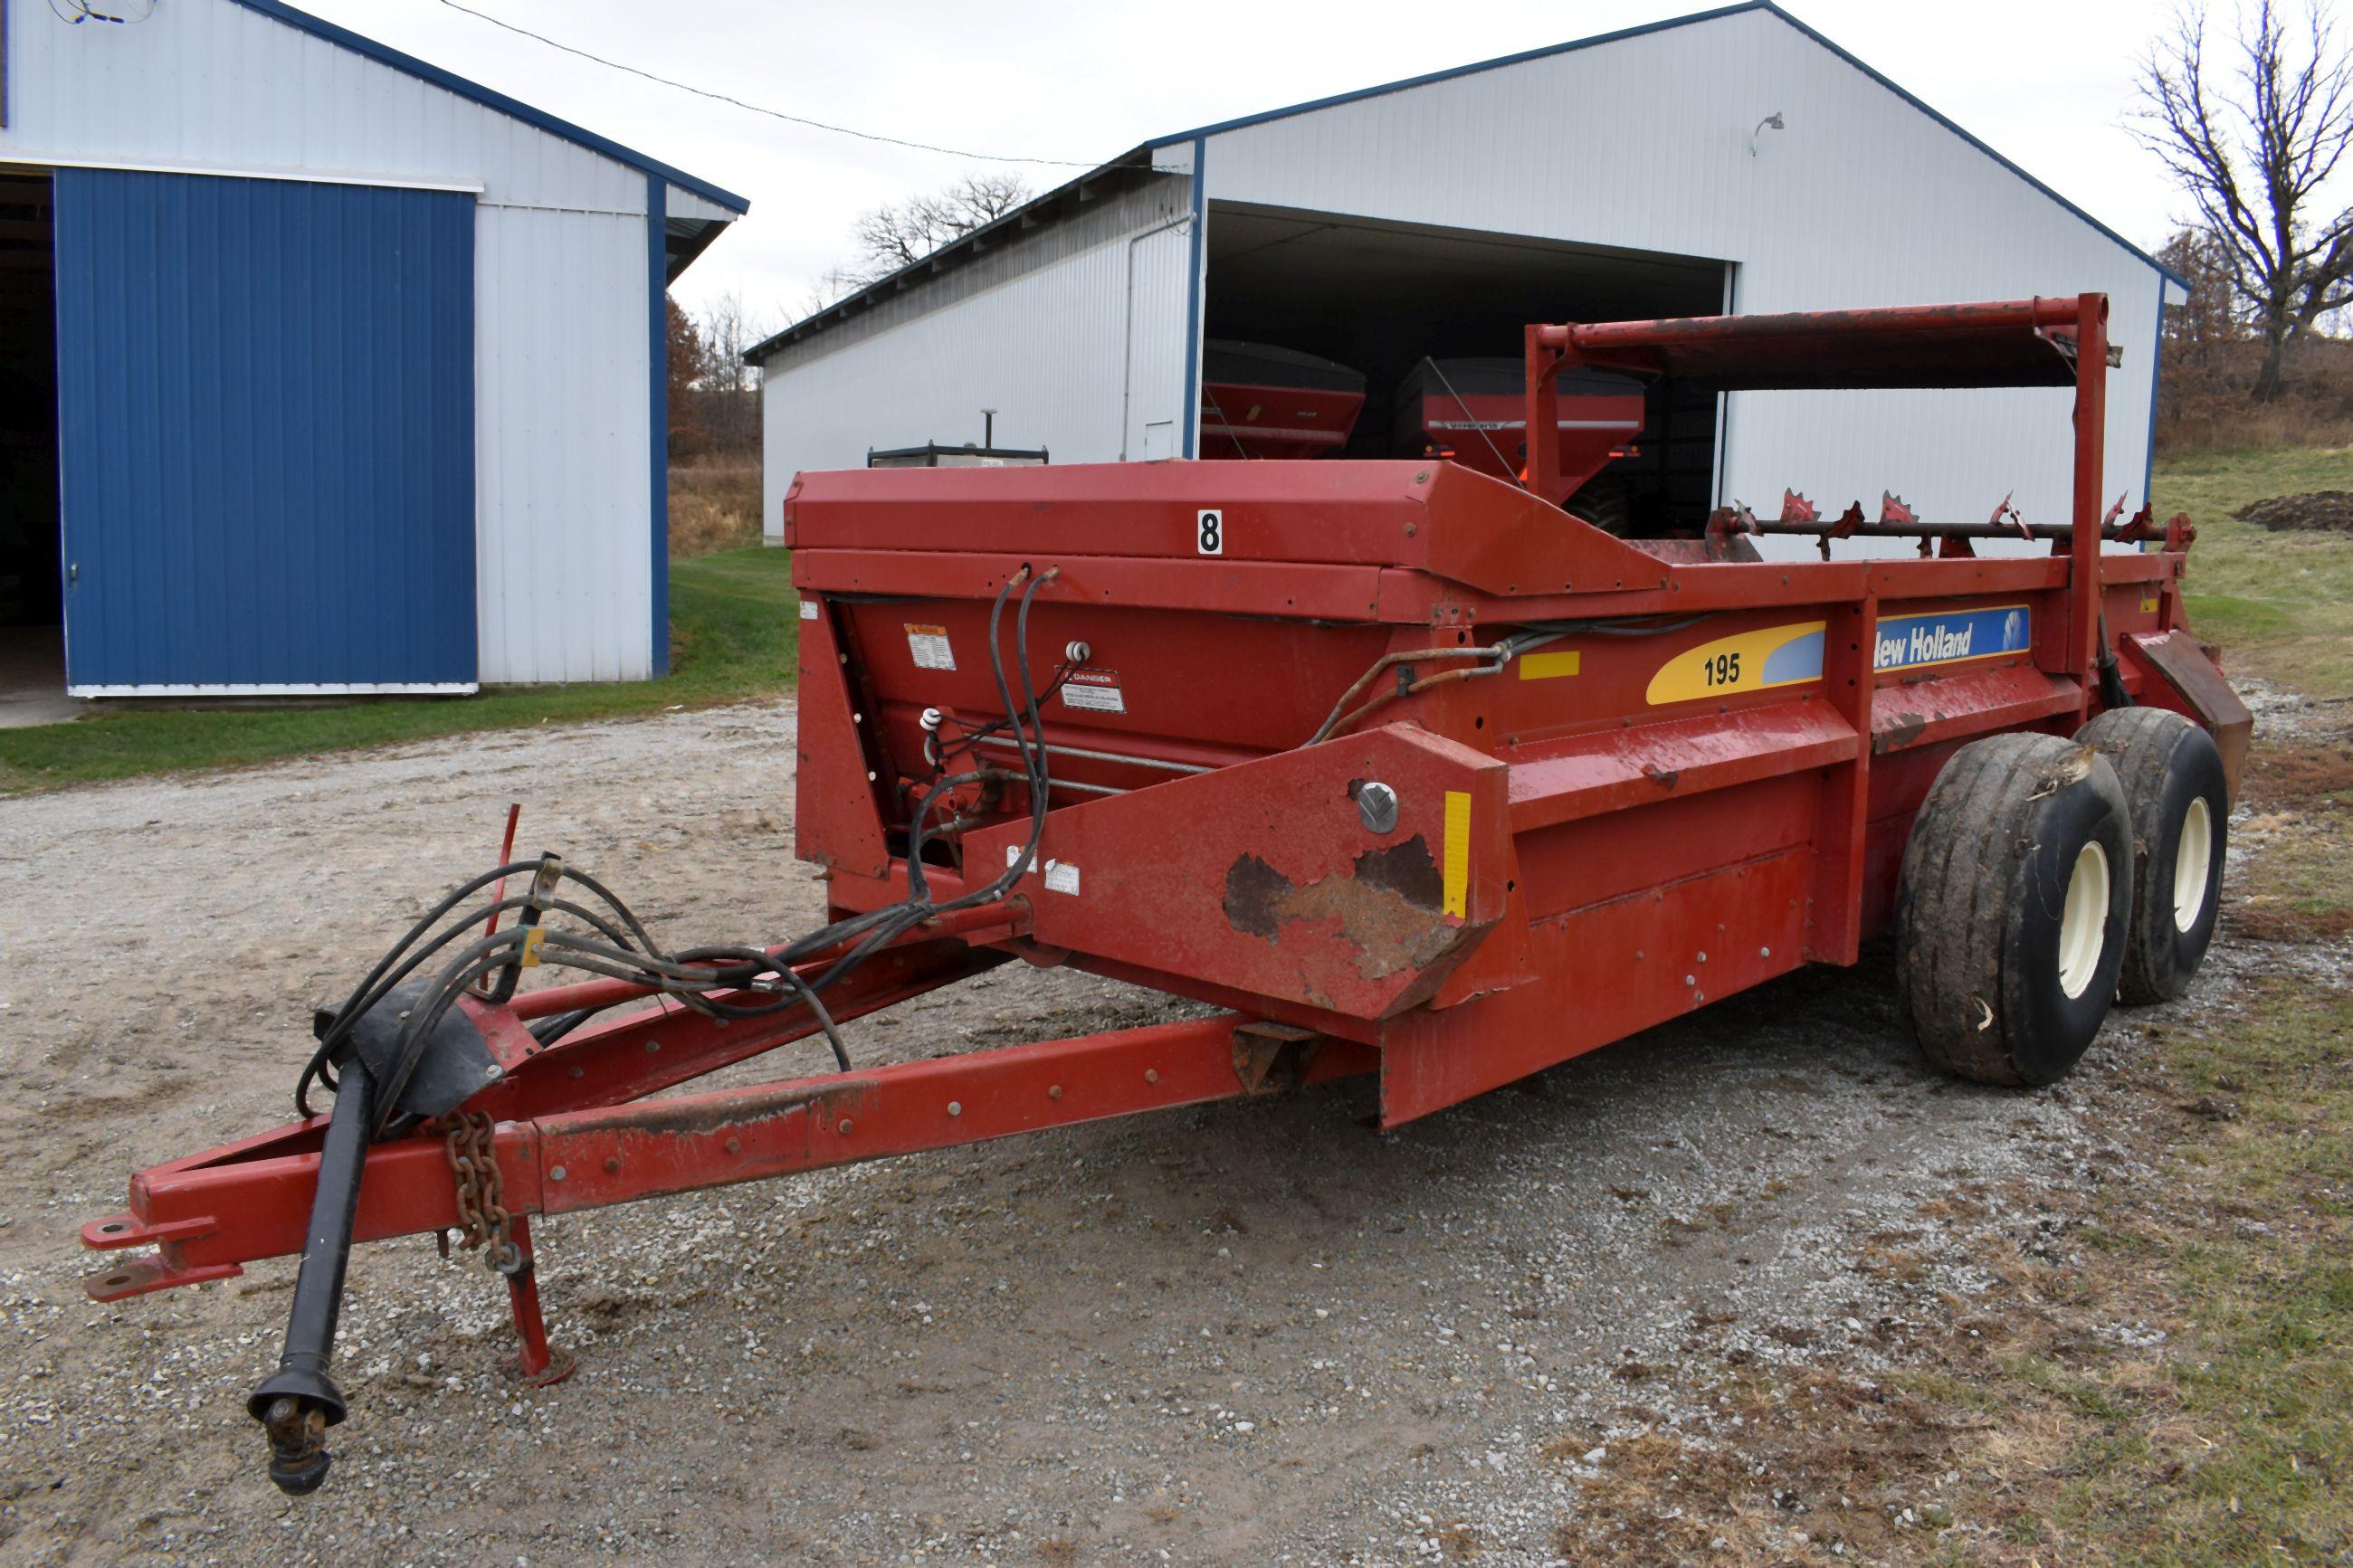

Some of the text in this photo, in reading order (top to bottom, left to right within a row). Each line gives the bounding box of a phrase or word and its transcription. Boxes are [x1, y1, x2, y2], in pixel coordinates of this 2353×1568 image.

[1200, 513, 1220, 552] 8
[1910, 622, 1974, 662] Holland
[1704, 652, 1740, 687] 195
